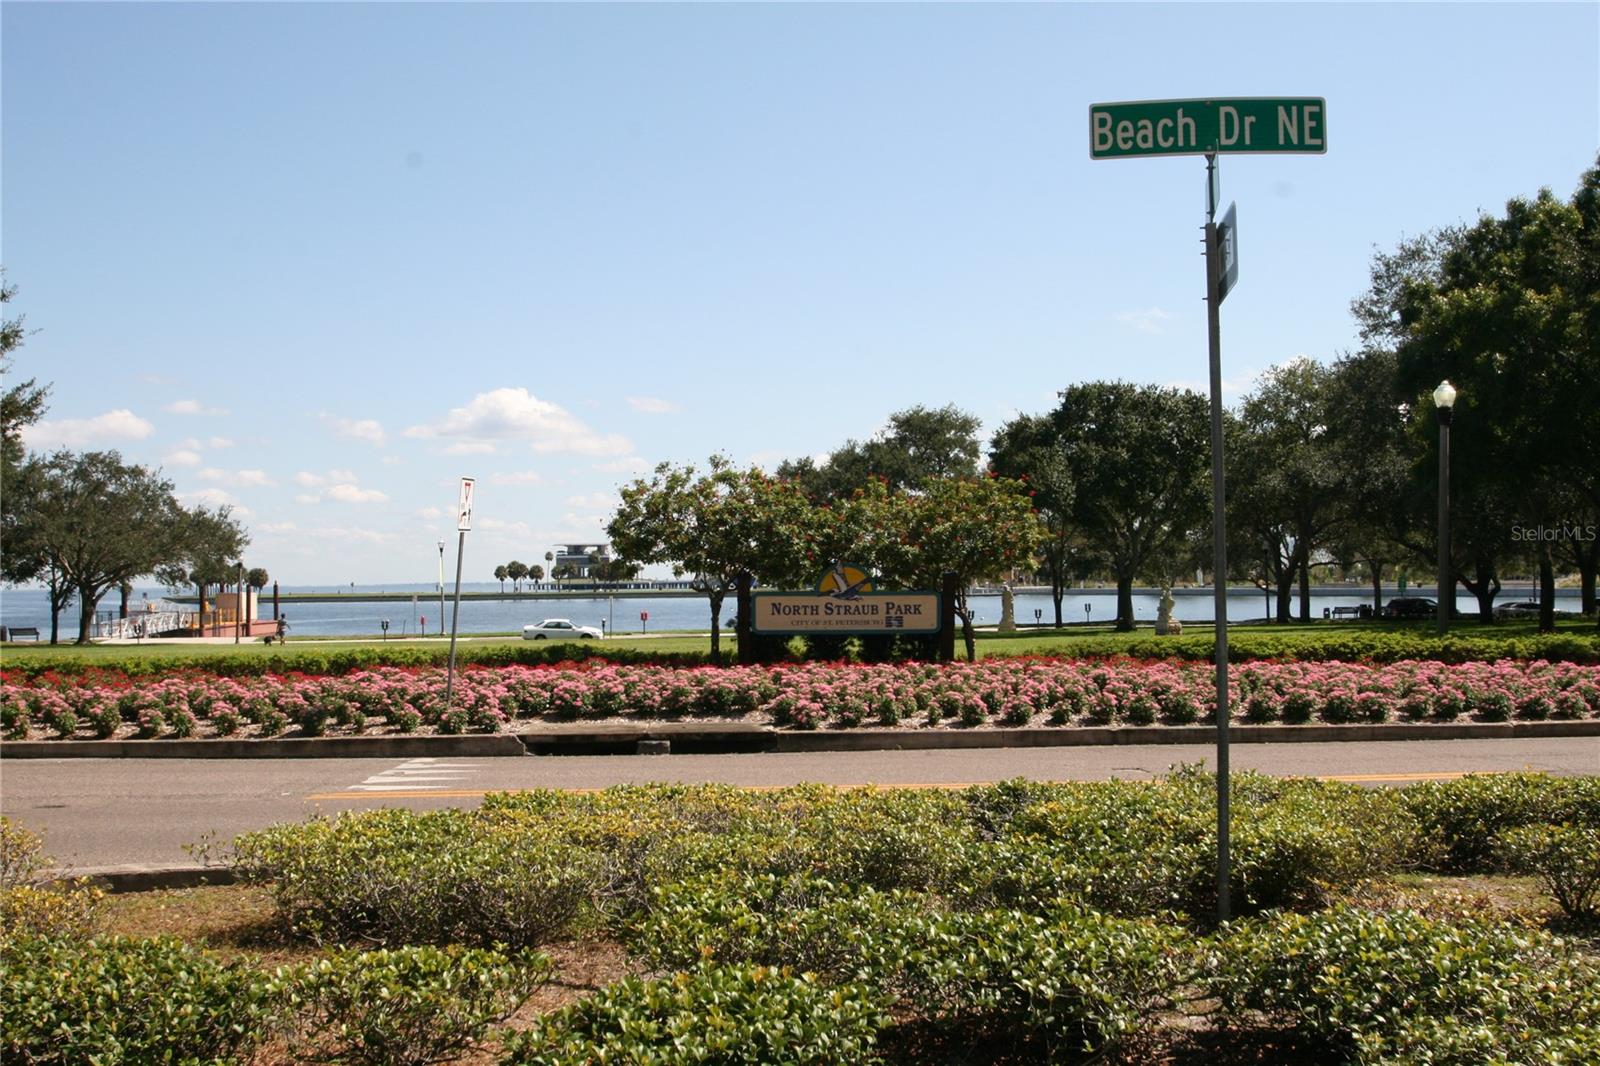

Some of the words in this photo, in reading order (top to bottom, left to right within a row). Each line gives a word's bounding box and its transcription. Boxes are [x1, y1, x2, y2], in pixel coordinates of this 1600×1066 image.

[1093, 108, 1196, 151] Beach
[1219, 106, 1256, 146] Dr
[1278, 105, 1323, 146] NE
[770, 602, 819, 616] NORTH
[824, 602, 879, 616] STRAUB
[885, 602, 922, 615] PARK
